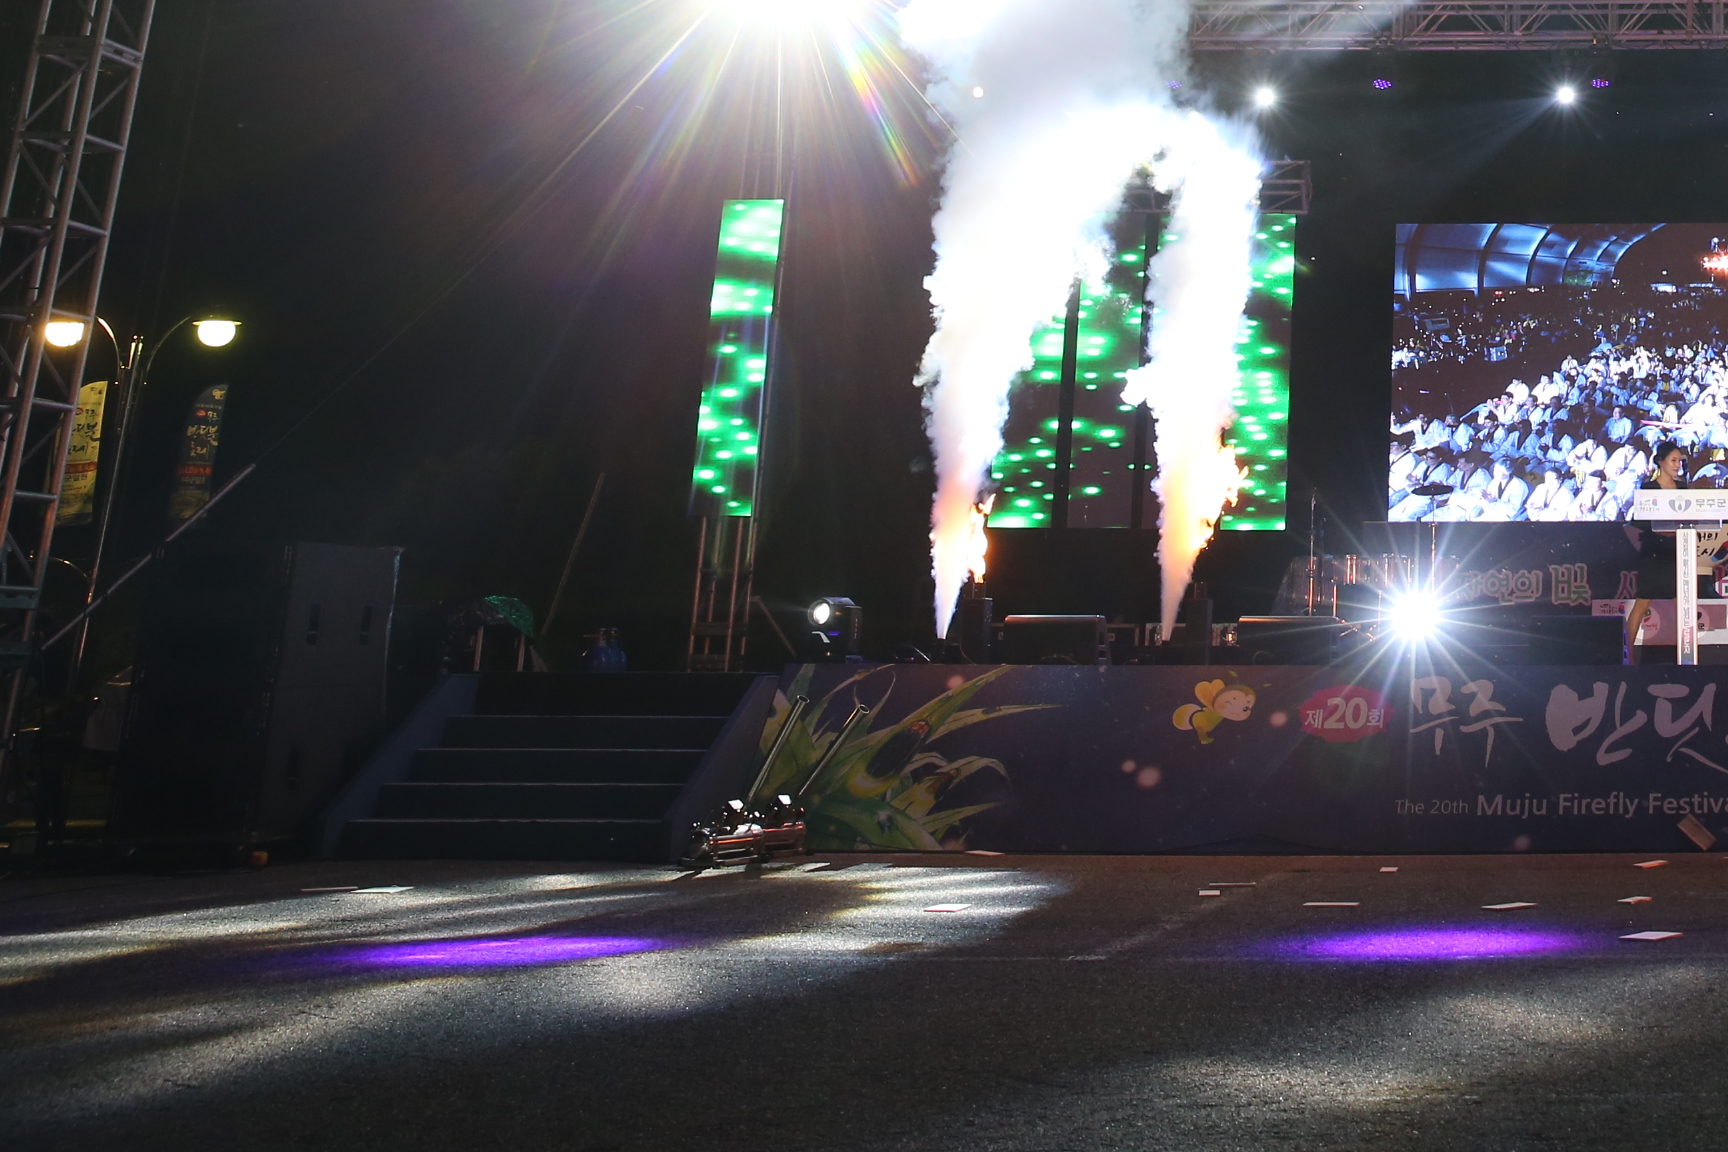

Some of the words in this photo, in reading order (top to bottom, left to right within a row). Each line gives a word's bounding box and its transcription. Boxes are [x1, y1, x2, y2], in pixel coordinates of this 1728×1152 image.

[71, 422, 100, 441] 딧불
[1695, 498, 1727, 508] 무주군
[1549, 562, 1592, 607] 빛
[1304, 696, 1384, 729] 제20회
[1409, 673, 1524, 768] 무주
[1395, 799, 1424, 814] The
[1430, 799, 1469, 814] 20th
[1477, 793, 1548, 819] Muju
[1558, 791, 1640, 819] Firefly
